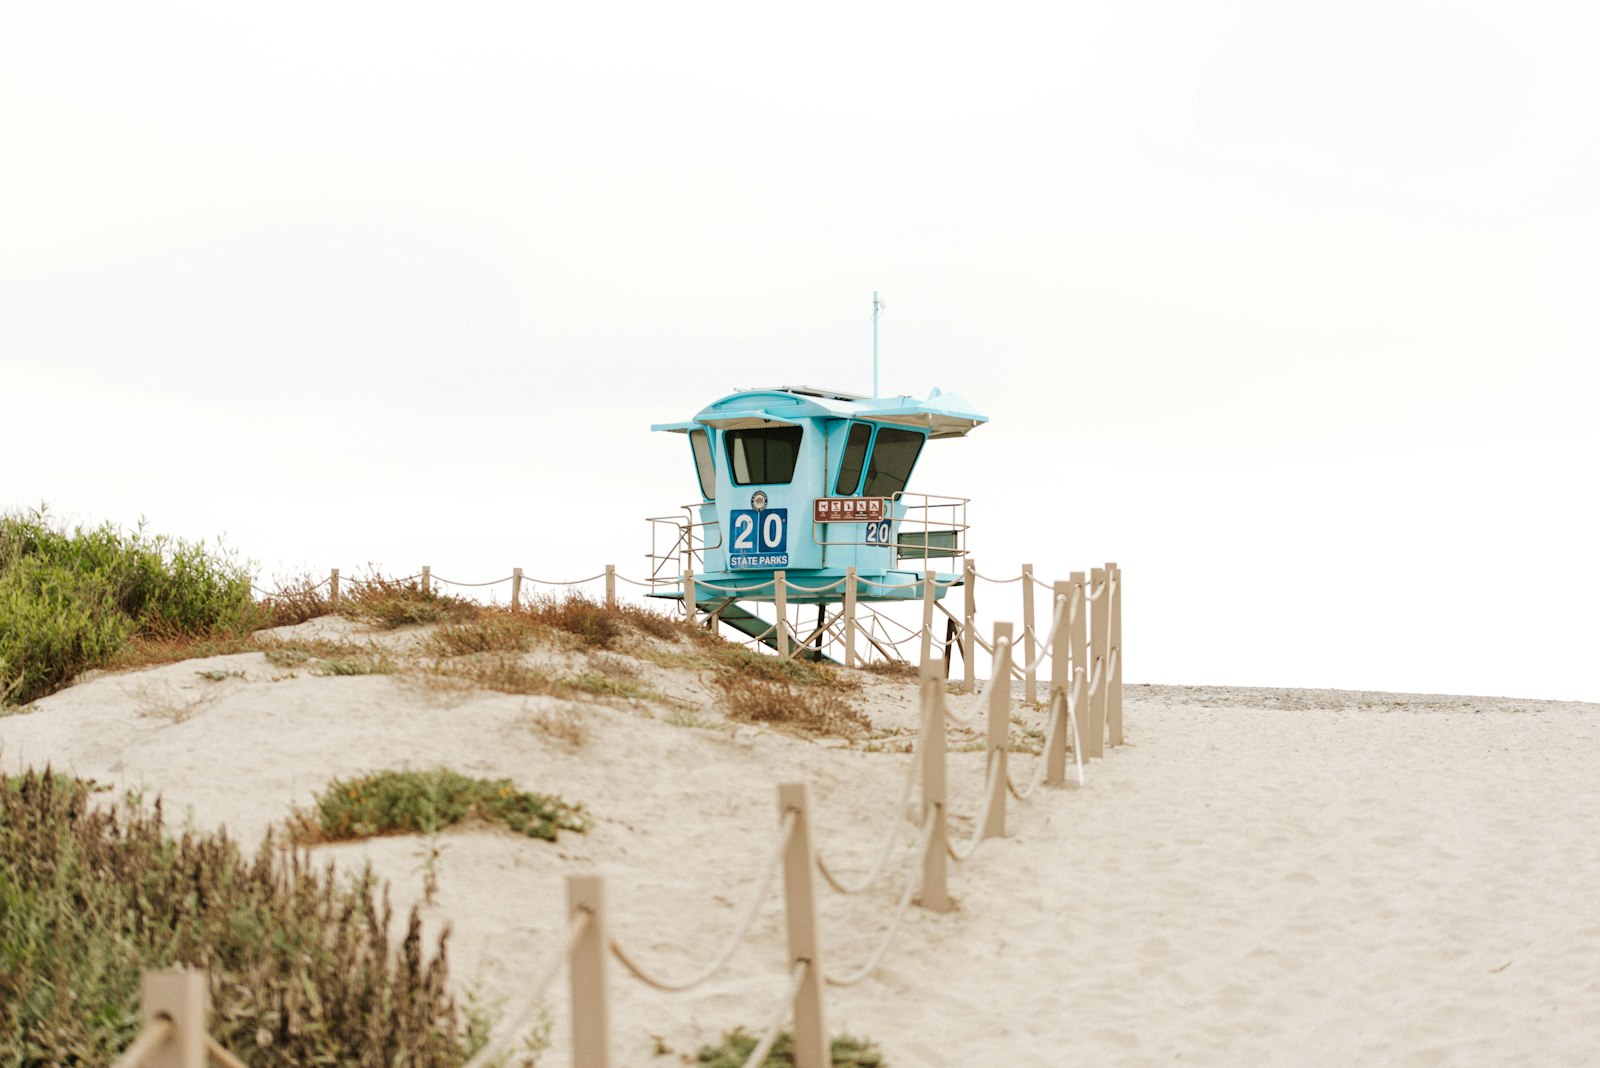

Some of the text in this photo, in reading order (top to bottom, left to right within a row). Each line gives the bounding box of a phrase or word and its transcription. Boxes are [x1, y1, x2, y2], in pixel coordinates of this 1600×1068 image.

[734, 514, 783, 549] 20
[867, 522, 889, 543] 20
[731, 555, 788, 566] STATE PARKS
